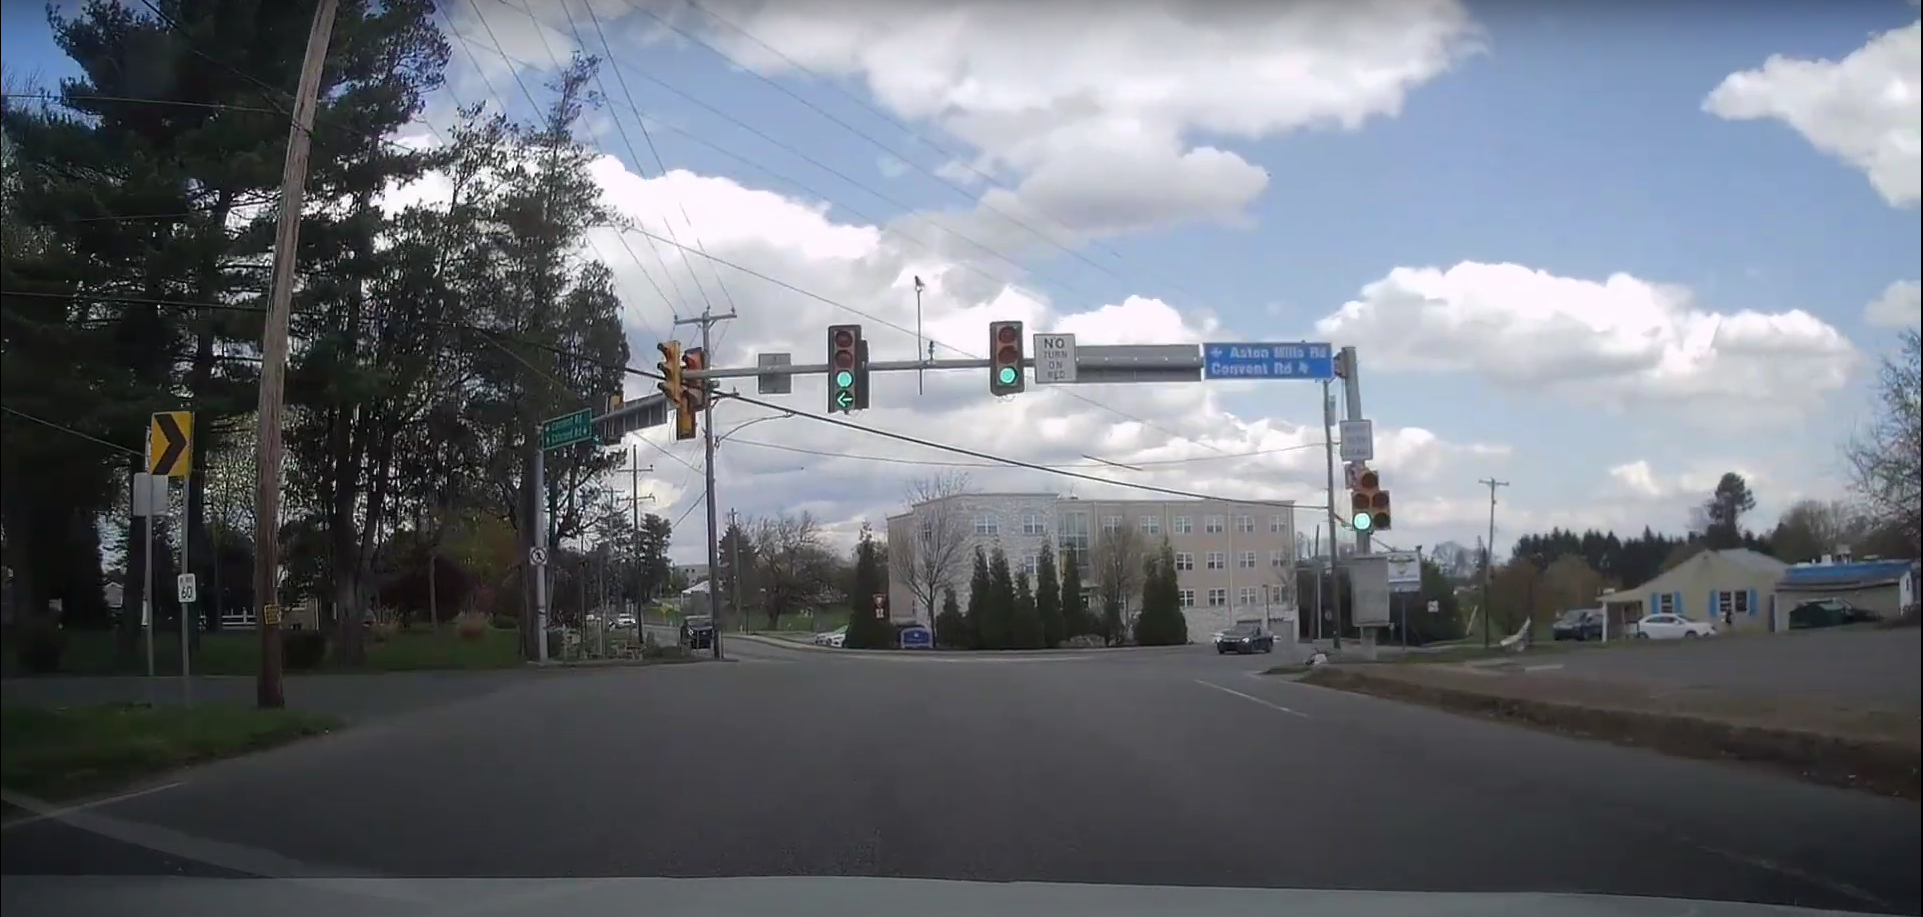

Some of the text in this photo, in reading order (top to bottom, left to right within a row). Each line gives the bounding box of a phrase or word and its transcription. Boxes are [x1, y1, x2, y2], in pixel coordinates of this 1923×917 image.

[1044, 337, 1065, 349] NO
[1043, 350, 1067, 359] TURN
[1229, 346, 1327, 359] Aston Mills Rd
[1049, 361, 1062, 369] ON
[1211, 361, 1293, 376] Convent Rd
[181, 585, 192, 599] 60
